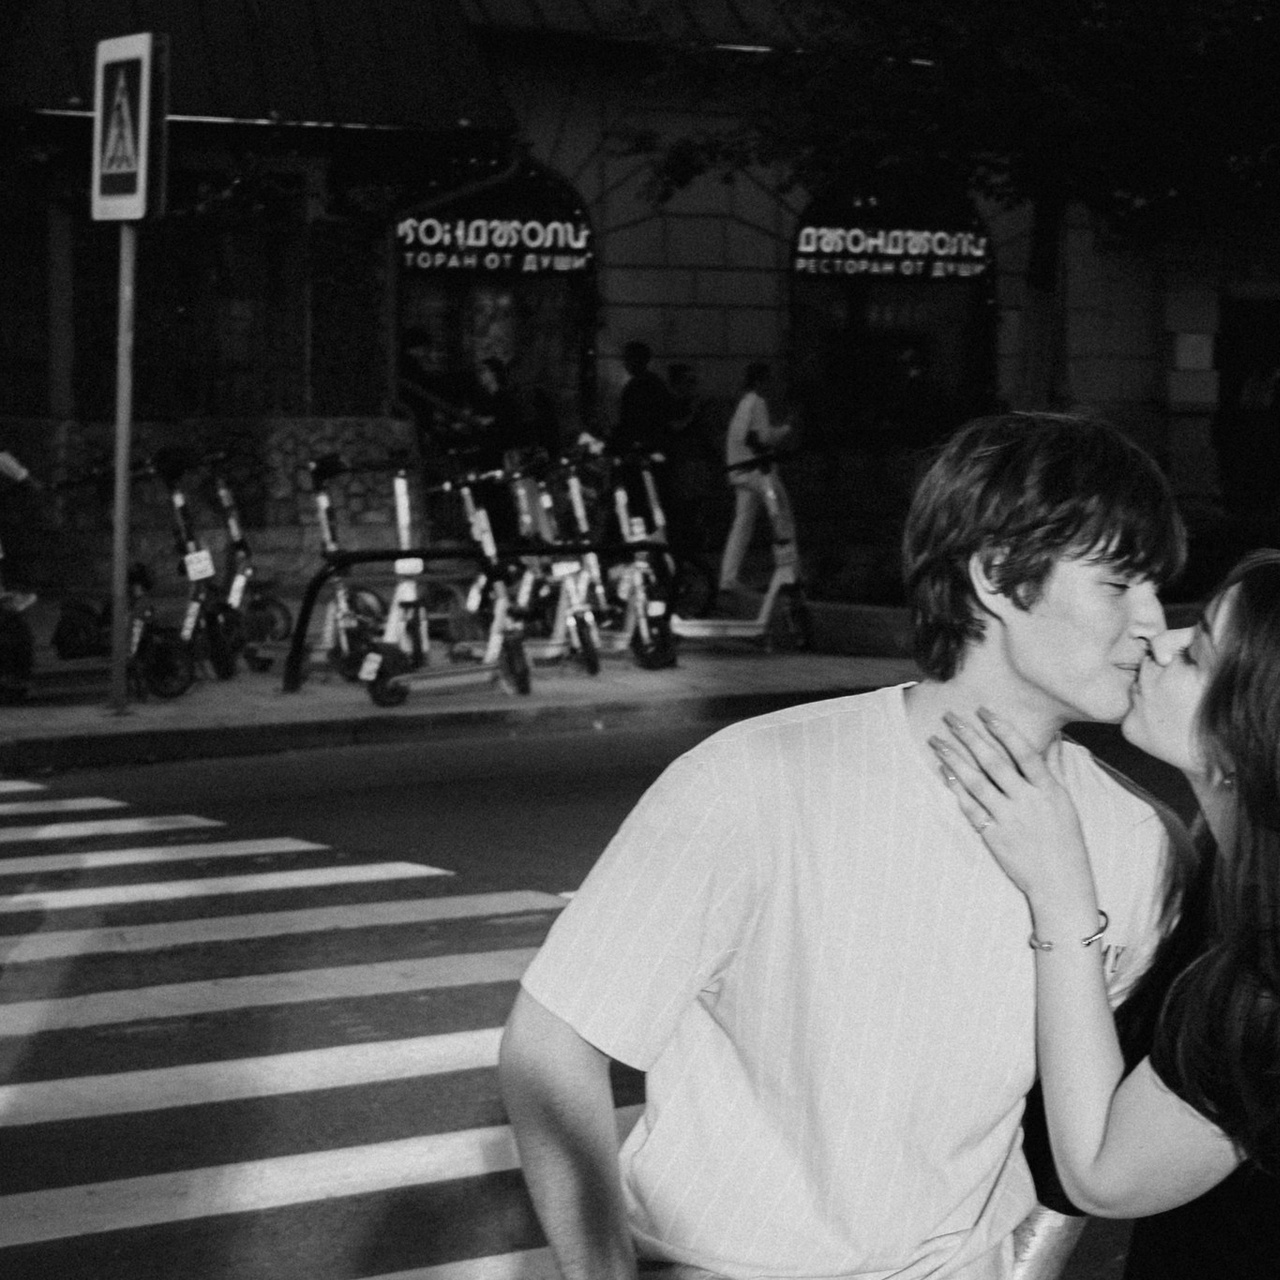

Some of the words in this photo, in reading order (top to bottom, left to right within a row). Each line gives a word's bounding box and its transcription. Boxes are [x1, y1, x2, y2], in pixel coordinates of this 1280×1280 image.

[484, 251, 513, 269] ОТ
[795, 257, 895, 274] РЕСТОРАН
[900, 260, 925, 275] ОТ
